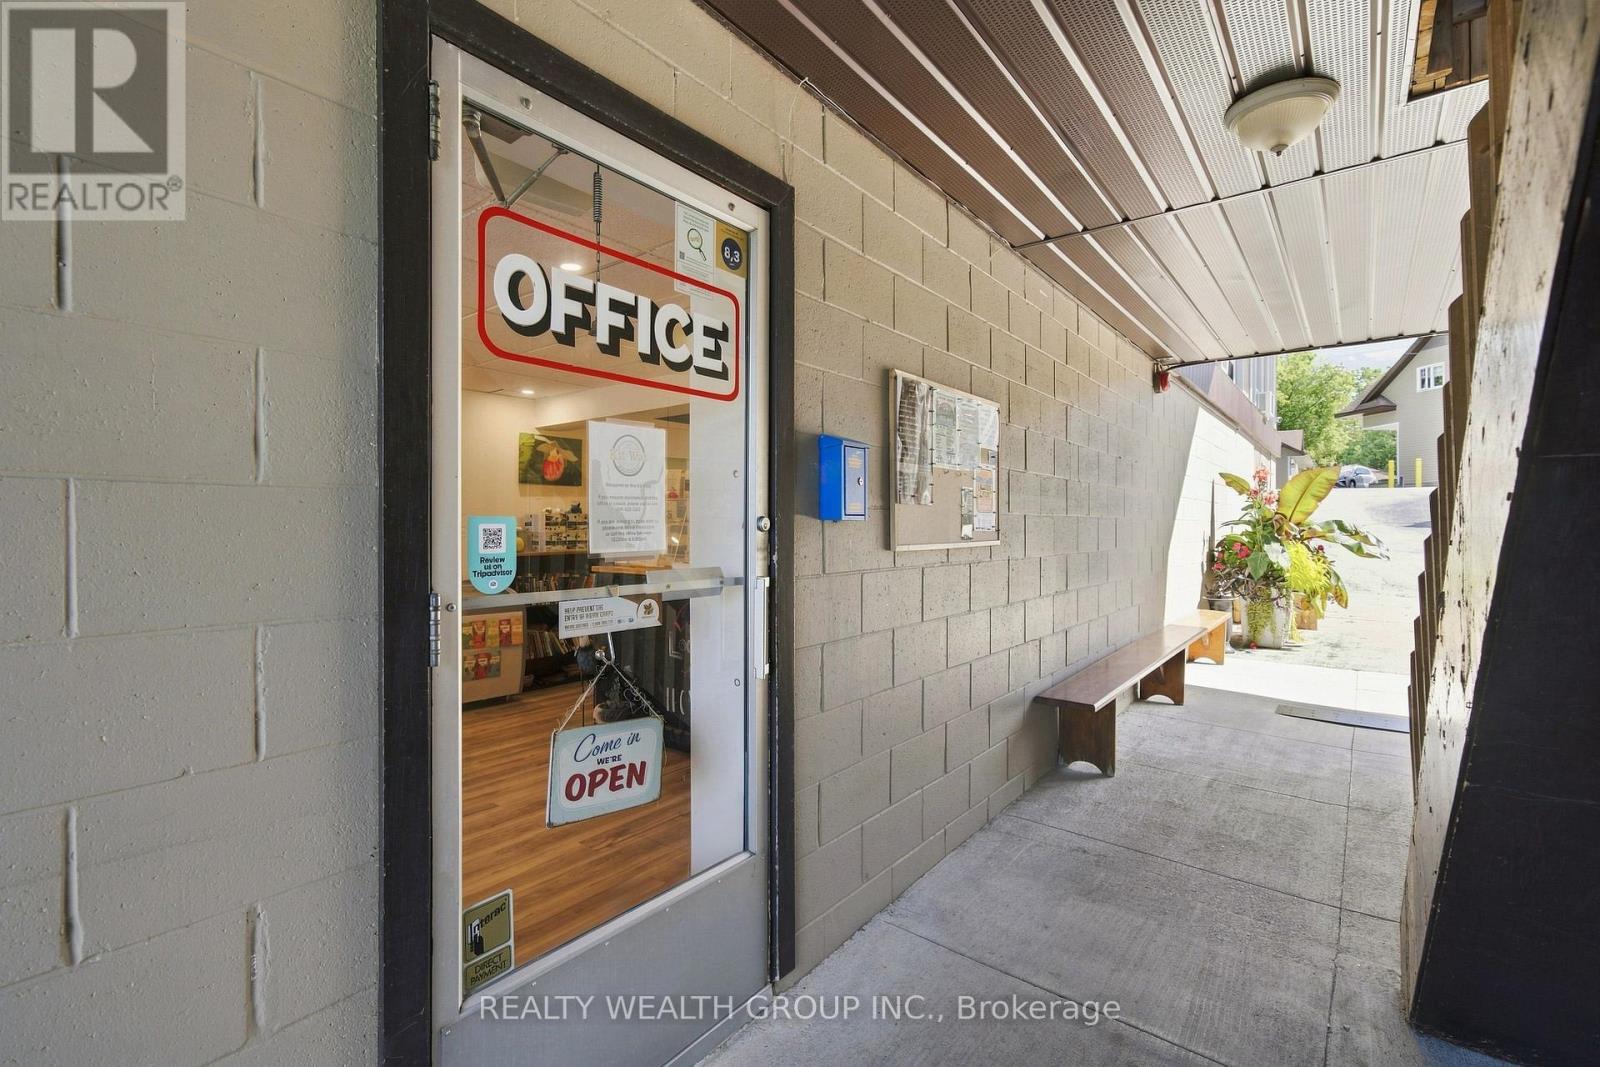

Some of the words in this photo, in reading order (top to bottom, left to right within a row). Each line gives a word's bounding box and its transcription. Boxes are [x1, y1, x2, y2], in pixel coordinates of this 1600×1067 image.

[724, 246, 741, 264] 8,3
[493, 253, 729, 381] OFFICE
[480, 556, 506, 564] Review
[472, 569, 513, 578] Tripadvisor
[574, 733, 622, 763] Come
[627, 732, 641, 746] in
[596, 754, 623, 765] WE'RE
[565, 760, 647, 802] OPEN
[470, 960, 508, 986] PAYMENT
[474, 953, 503, 975] DIRECT
